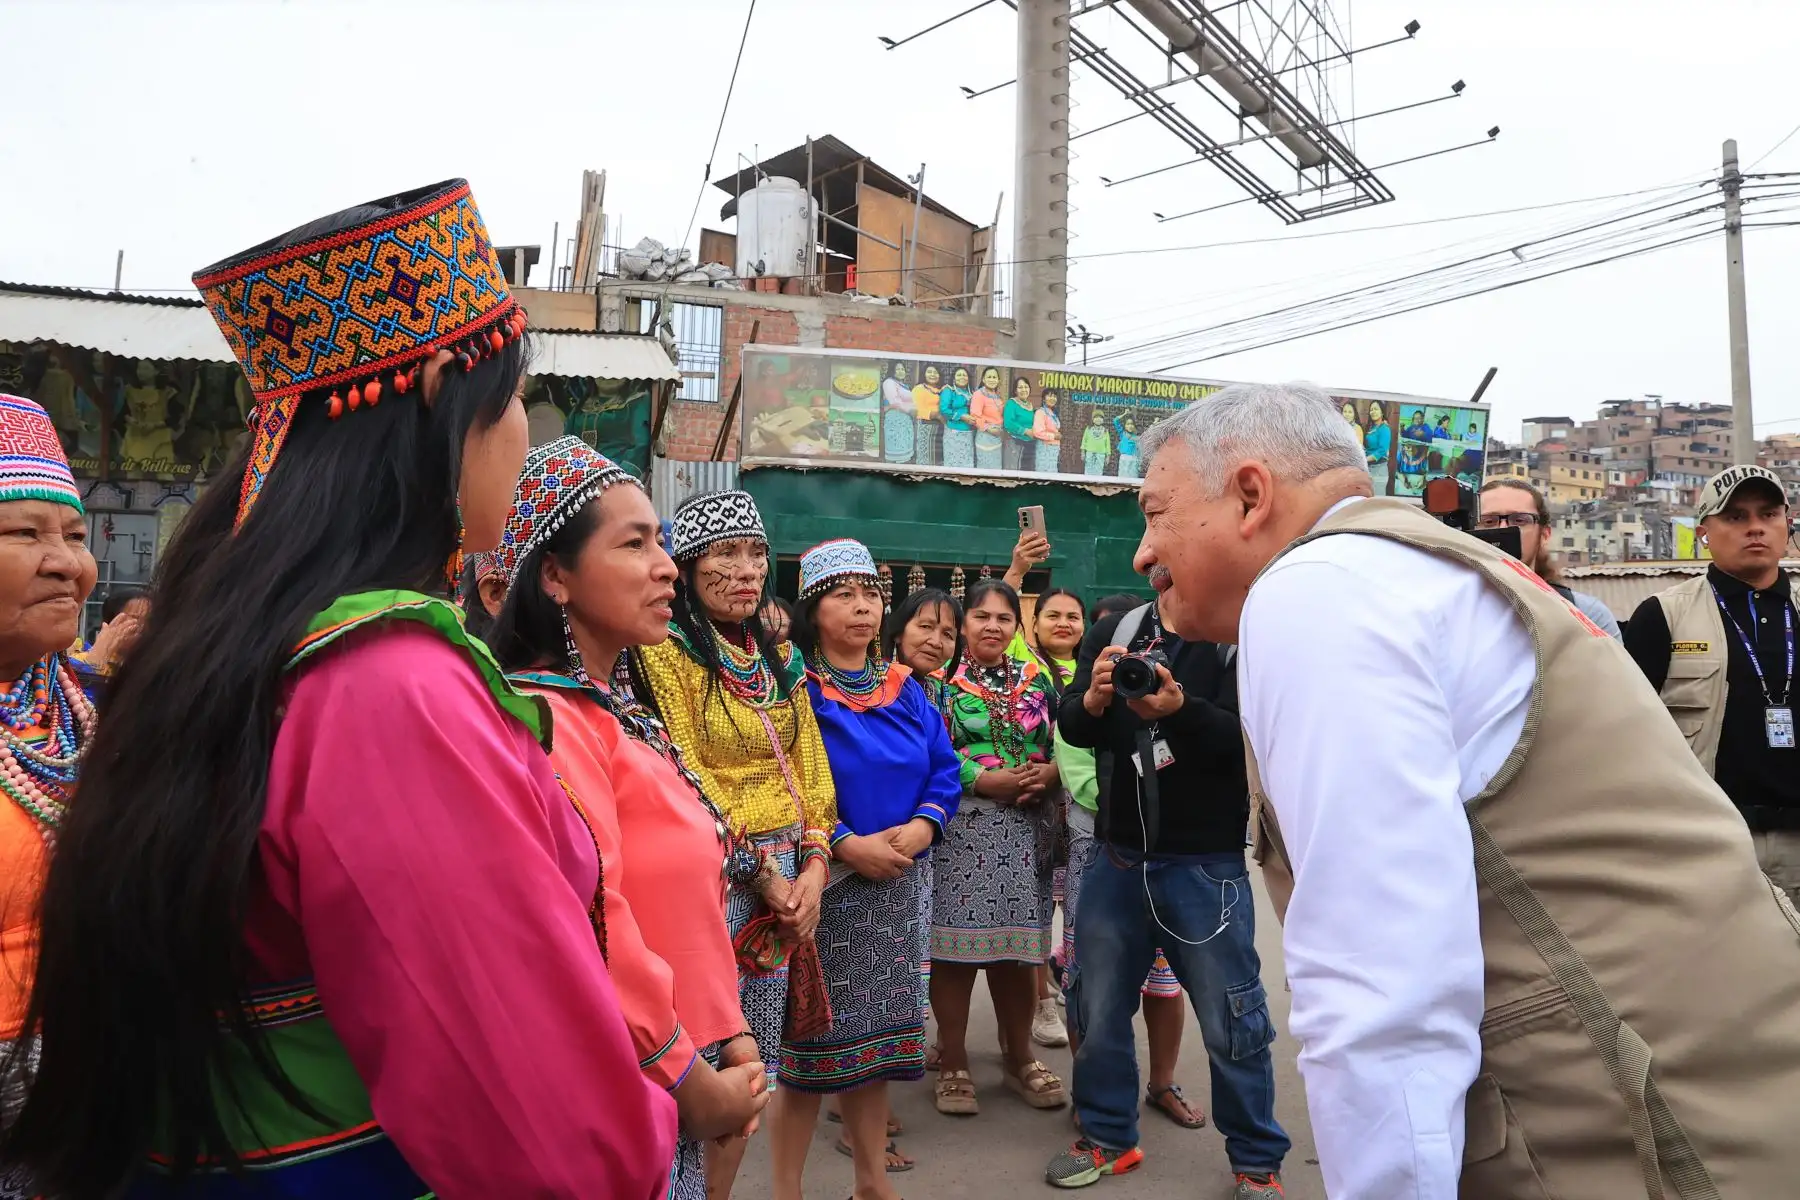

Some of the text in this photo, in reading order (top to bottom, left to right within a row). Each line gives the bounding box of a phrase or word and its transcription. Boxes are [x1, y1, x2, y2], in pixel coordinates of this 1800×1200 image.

[1039, 371, 1093, 391] JAINOAX
[1095, 376, 1142, 395] MAROTI
[1144, 381, 1177, 398] XOBO
[120, 457, 136, 471] de
